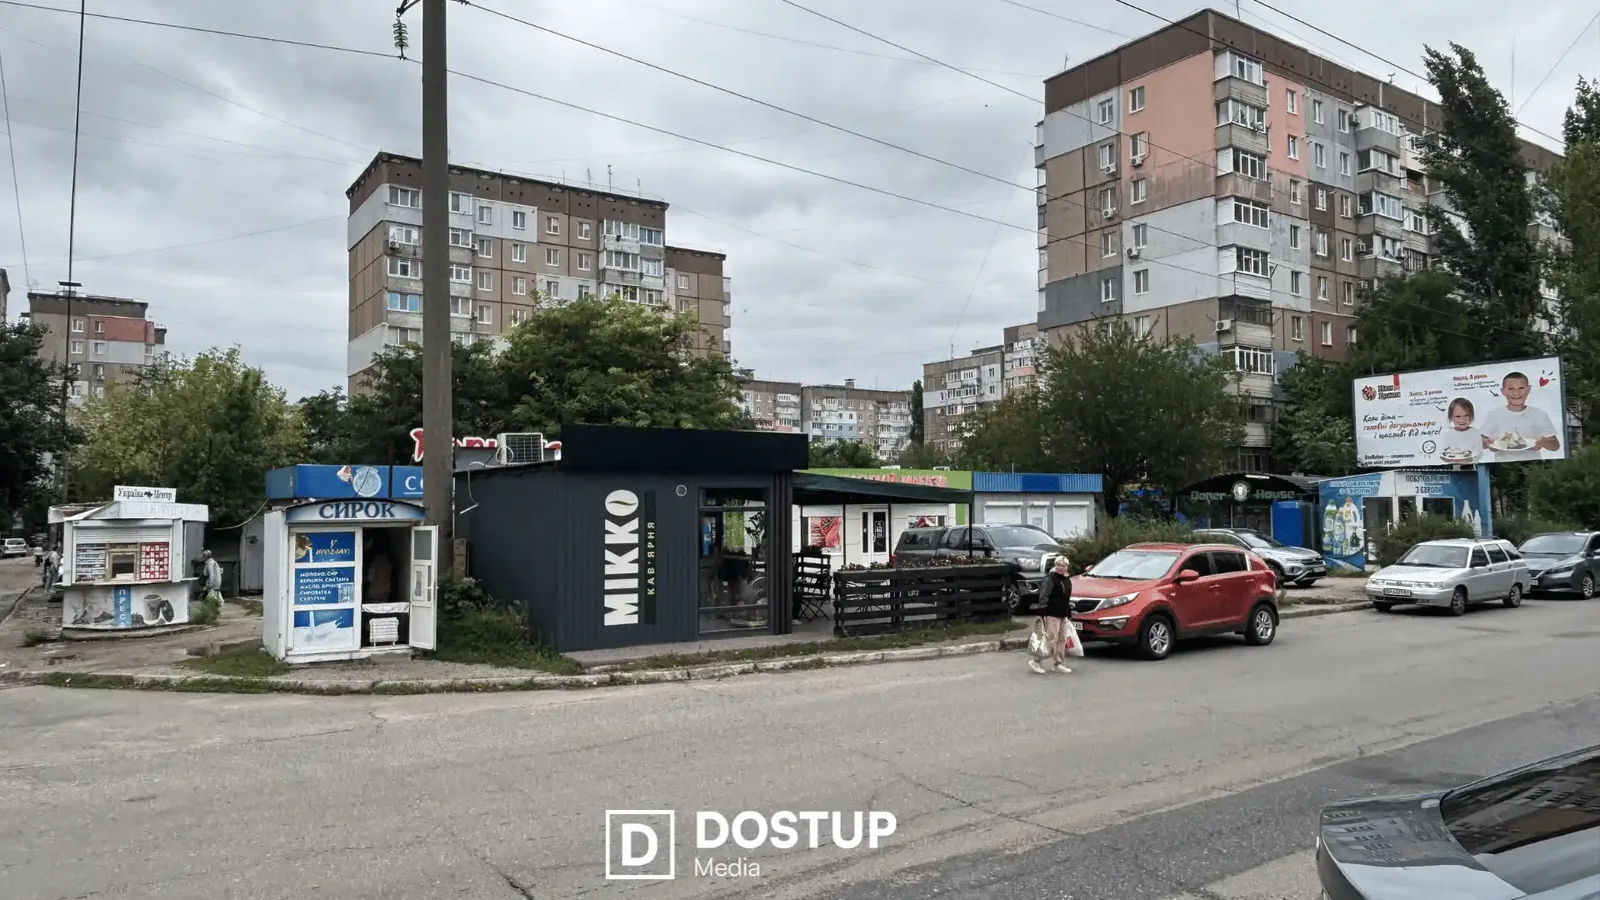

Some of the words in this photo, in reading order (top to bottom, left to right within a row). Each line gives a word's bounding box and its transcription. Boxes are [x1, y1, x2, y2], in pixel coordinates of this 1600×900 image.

[154, 490, 172, 500] Центр
[1191, 490, 1226, 500] Doner
[1255, 489, 1295, 499] House
[319, 502, 396, 519] СИРОК
[604, 489, 639, 626] MIKKO
